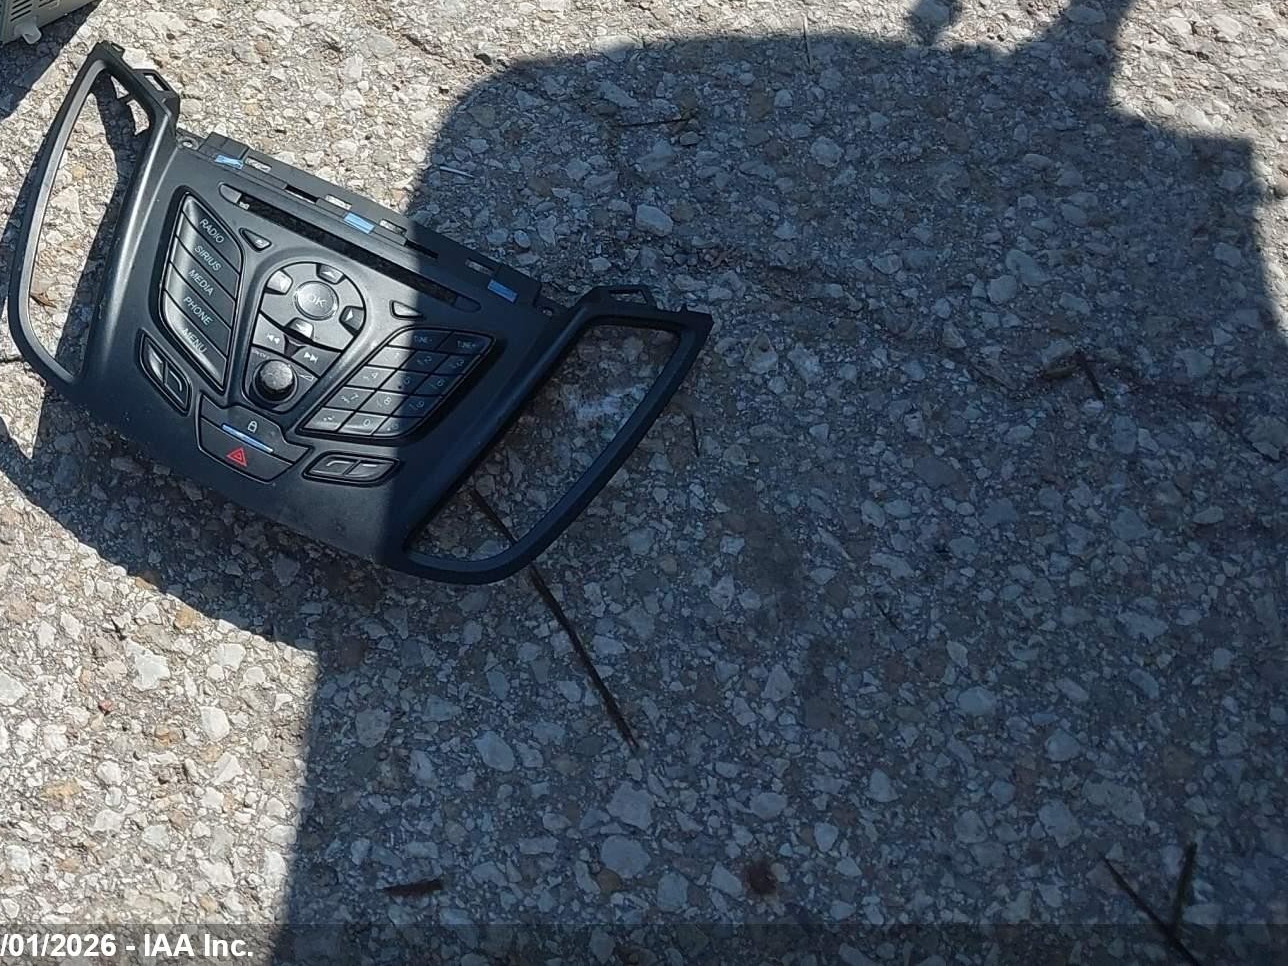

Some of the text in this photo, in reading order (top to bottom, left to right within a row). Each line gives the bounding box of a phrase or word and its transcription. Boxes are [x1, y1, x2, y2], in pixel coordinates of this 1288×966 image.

[199, 218, 225, 244] RADIO
[194, 245, 222, 271] SIRIUS
[189, 269, 214, 296] MEDIA
[183, 296, 213, 326] PHONE
[182, 328, 208, 354] MENU
[363, 418, 372, 427] 0
